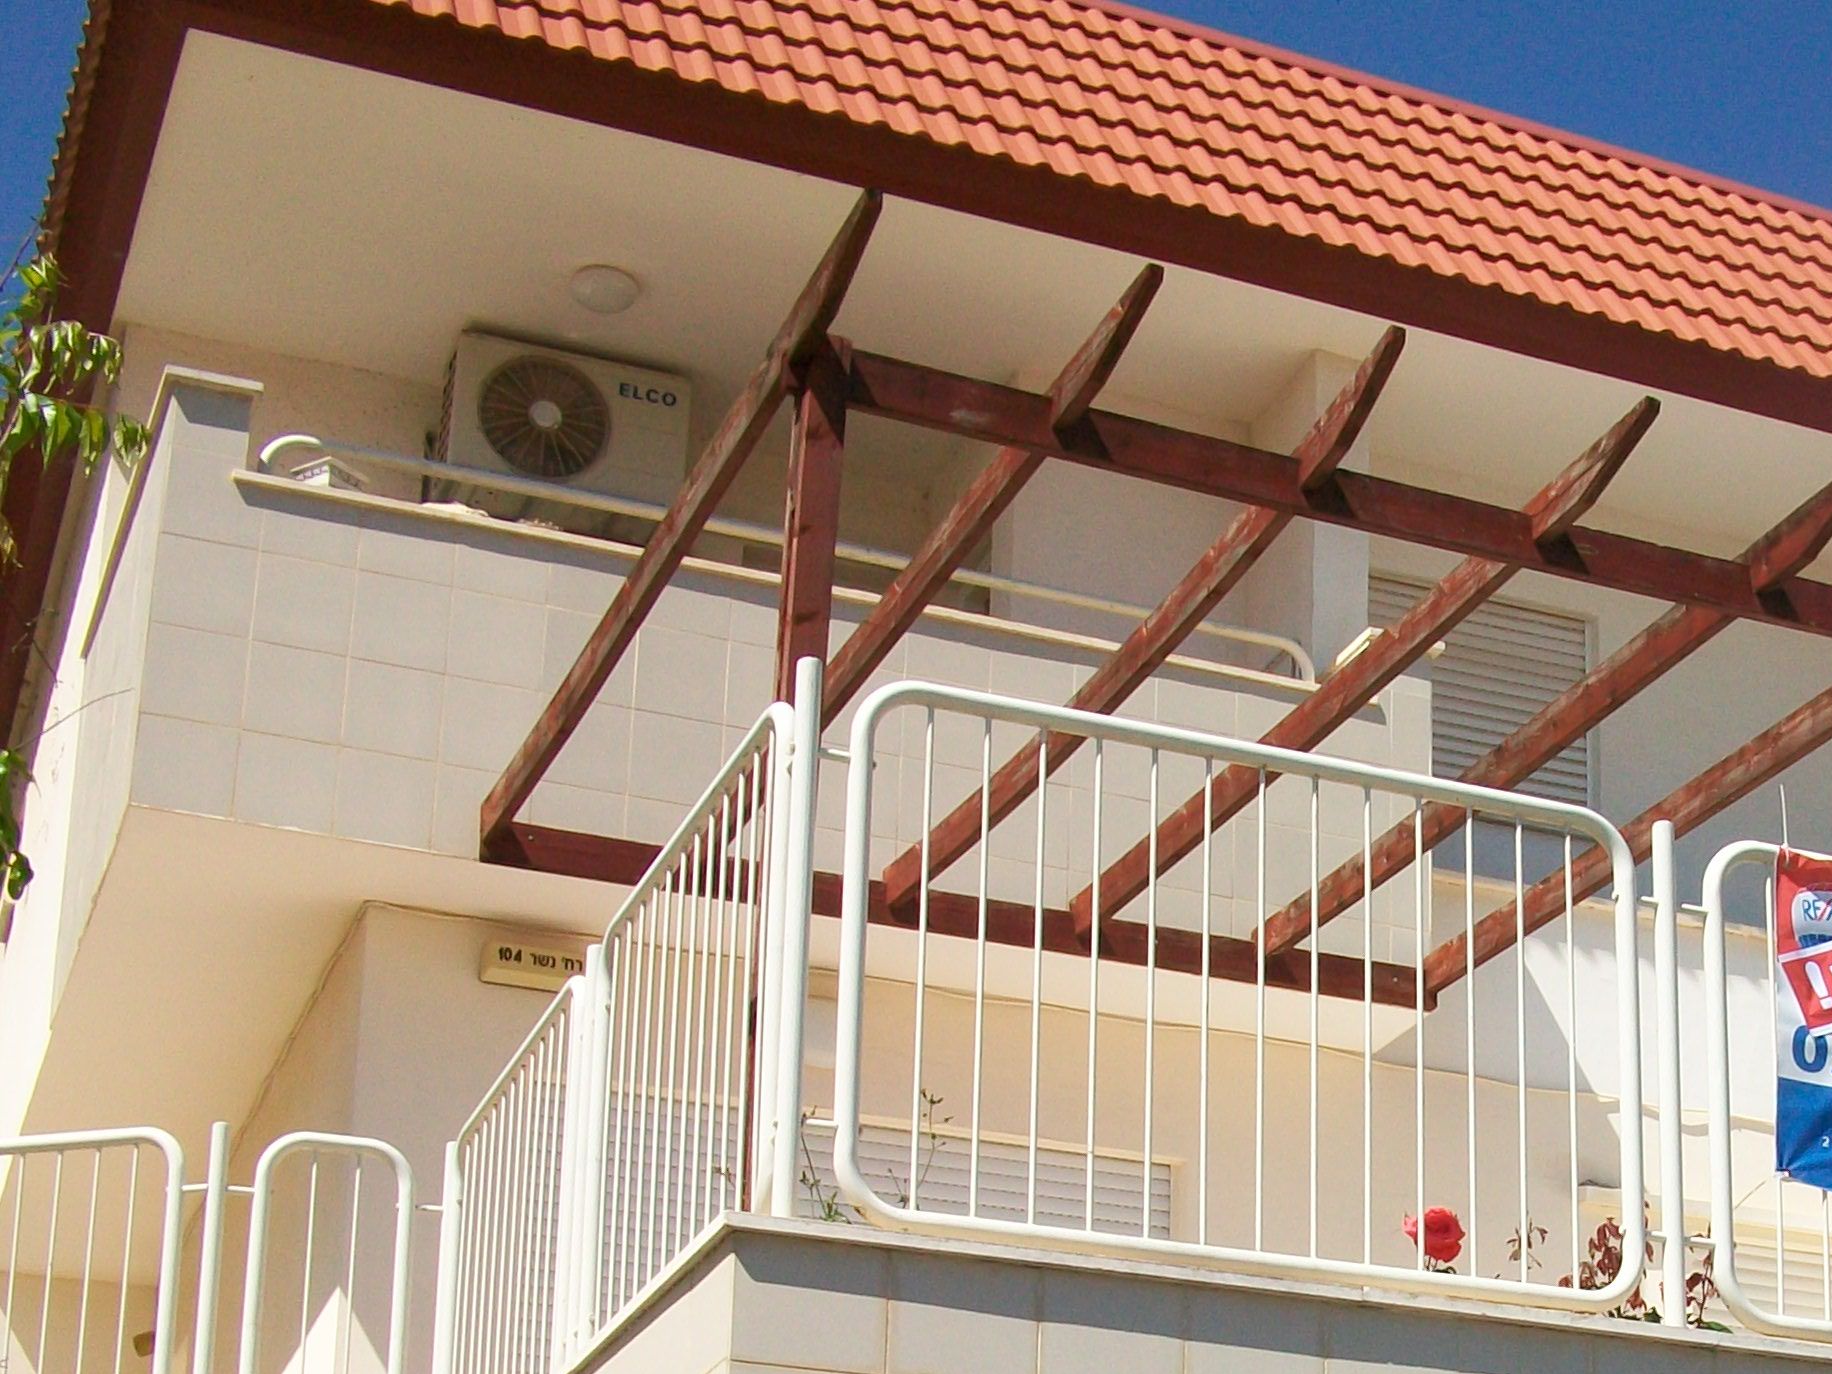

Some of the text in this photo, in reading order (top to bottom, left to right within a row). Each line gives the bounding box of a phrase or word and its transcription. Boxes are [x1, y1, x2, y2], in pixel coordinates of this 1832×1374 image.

[619, 382, 677, 407] ELCO
[498, 946, 523, 964] 104
[529, 952, 557, 969] נשר
